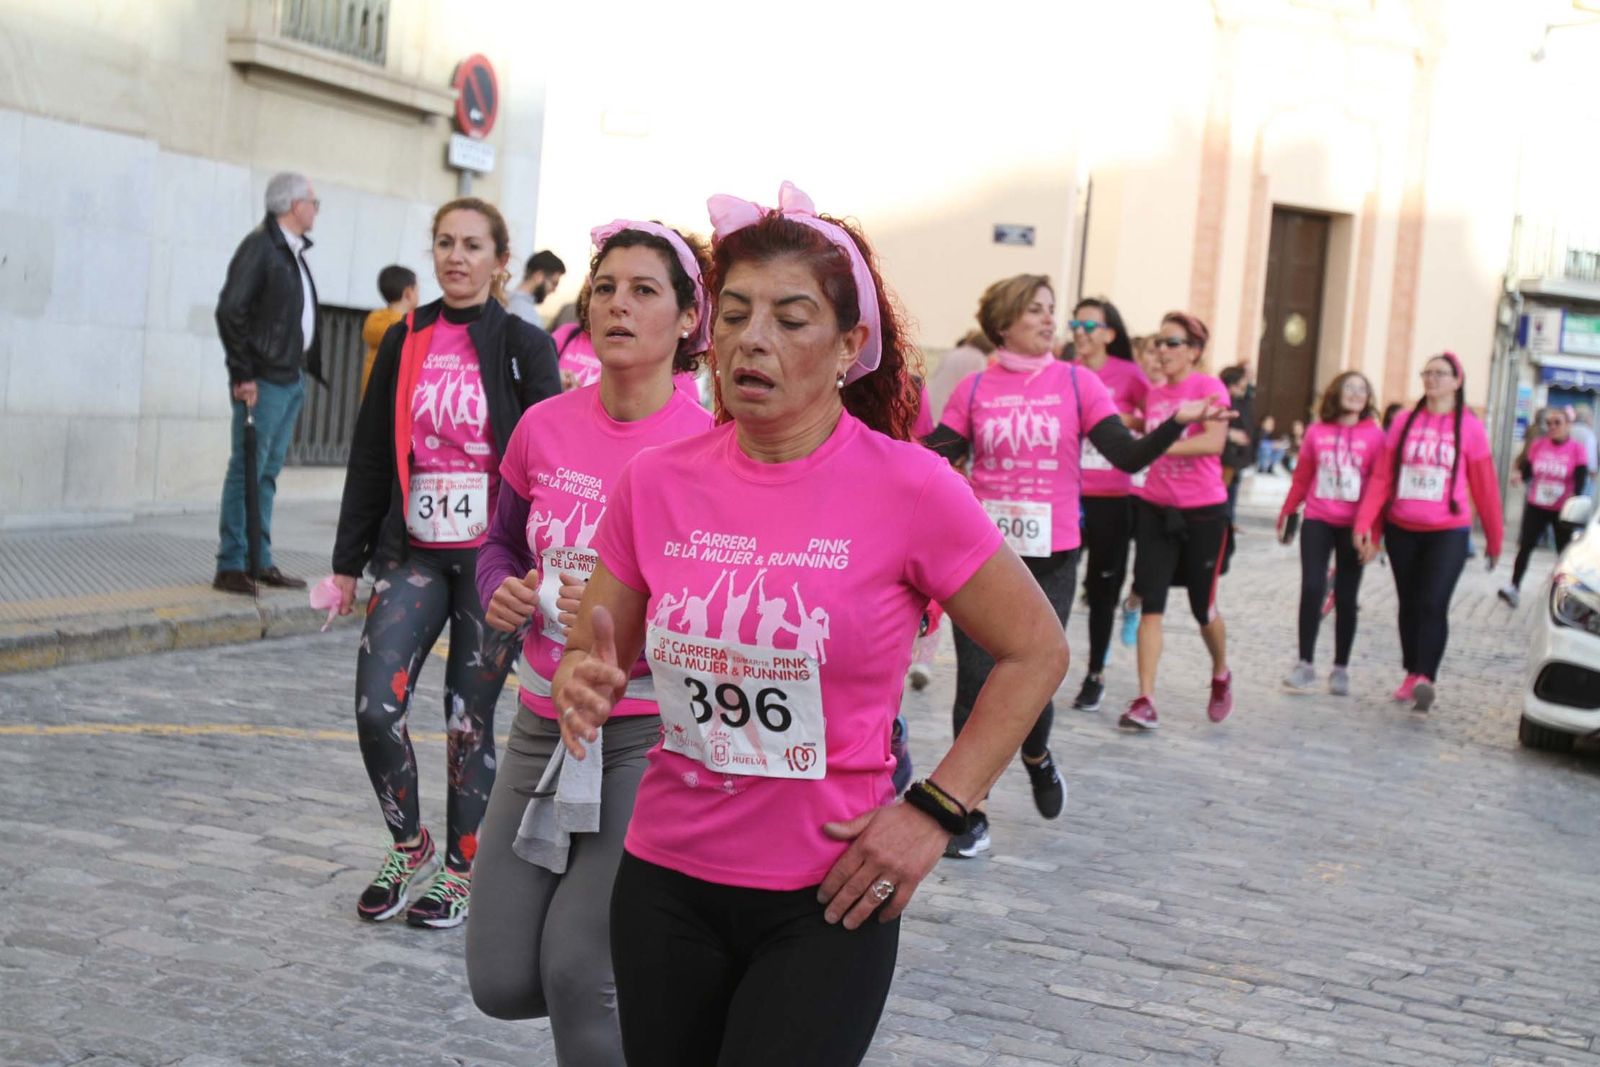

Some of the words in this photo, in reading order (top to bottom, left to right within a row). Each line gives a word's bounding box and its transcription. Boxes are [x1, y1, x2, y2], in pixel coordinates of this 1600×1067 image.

[537, 472, 550, 485] DE
[548, 476, 561, 489] LA
[561, 480, 600, 501] MUJER
[599, 494, 607, 503] &
[556, 467, 603, 490] CARRERA
[418, 494, 472, 519] 314
[997, 517, 1040, 539] 609
[690, 530, 758, 551] CARRERA
[807, 538, 851, 554] PINK
[551, 558, 562, 568] DE
[564, 561, 575, 570] LA
[664, 541, 680, 557] DE
[681, 544, 698, 559] LA
[700, 548, 754, 565] MUJER
[754, 555, 764, 566] &
[768, 553, 849, 570] RUNNING
[653, 648, 668, 661] DE
[669, 653, 682, 667] LA
[685, 658, 728, 675] MUJER
[731, 666, 740, 677] &
[743, 666, 810, 681] RUNNING
[672, 641, 728, 662] CARRERA
[773, 657, 808, 669] PINK
[684, 677, 792, 732] 396
[732, 755, 768, 767] HUELVA
